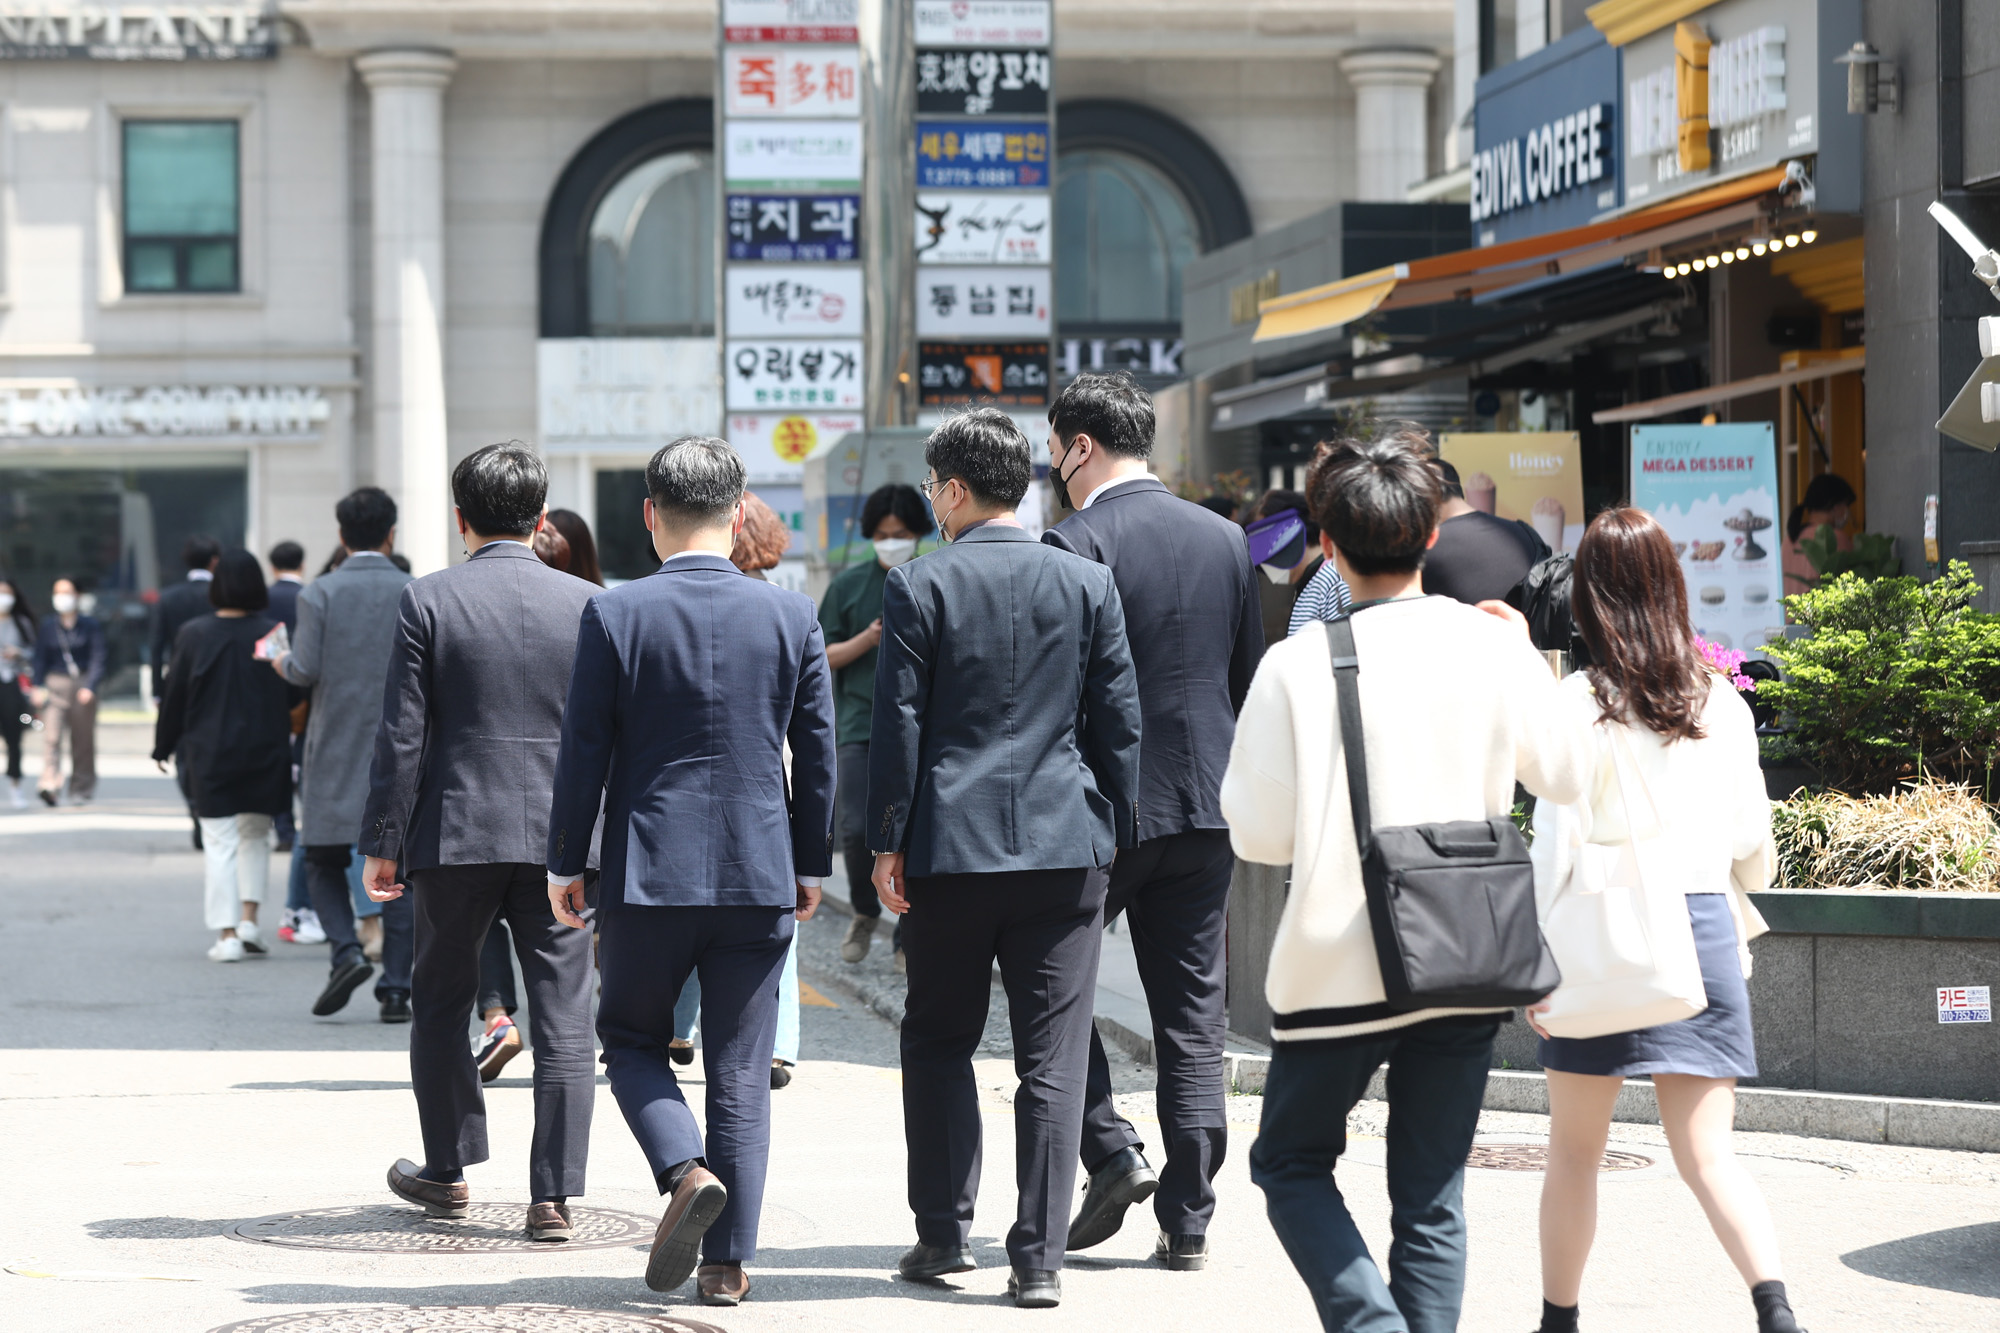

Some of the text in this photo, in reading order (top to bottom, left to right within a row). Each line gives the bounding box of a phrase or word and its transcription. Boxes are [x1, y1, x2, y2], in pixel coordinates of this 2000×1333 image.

[739, 58, 774, 107] 죽
[1470, 103, 1602, 222] EDIYA COFFEE
[757, 198, 858, 242] 치과
[931, 284, 1034, 317] 동남집
[1509, 452, 1564, 472] Honey
[1643, 455, 1754, 473] MEGA DESSERT
[1940, 989, 1967, 1010] 카드
